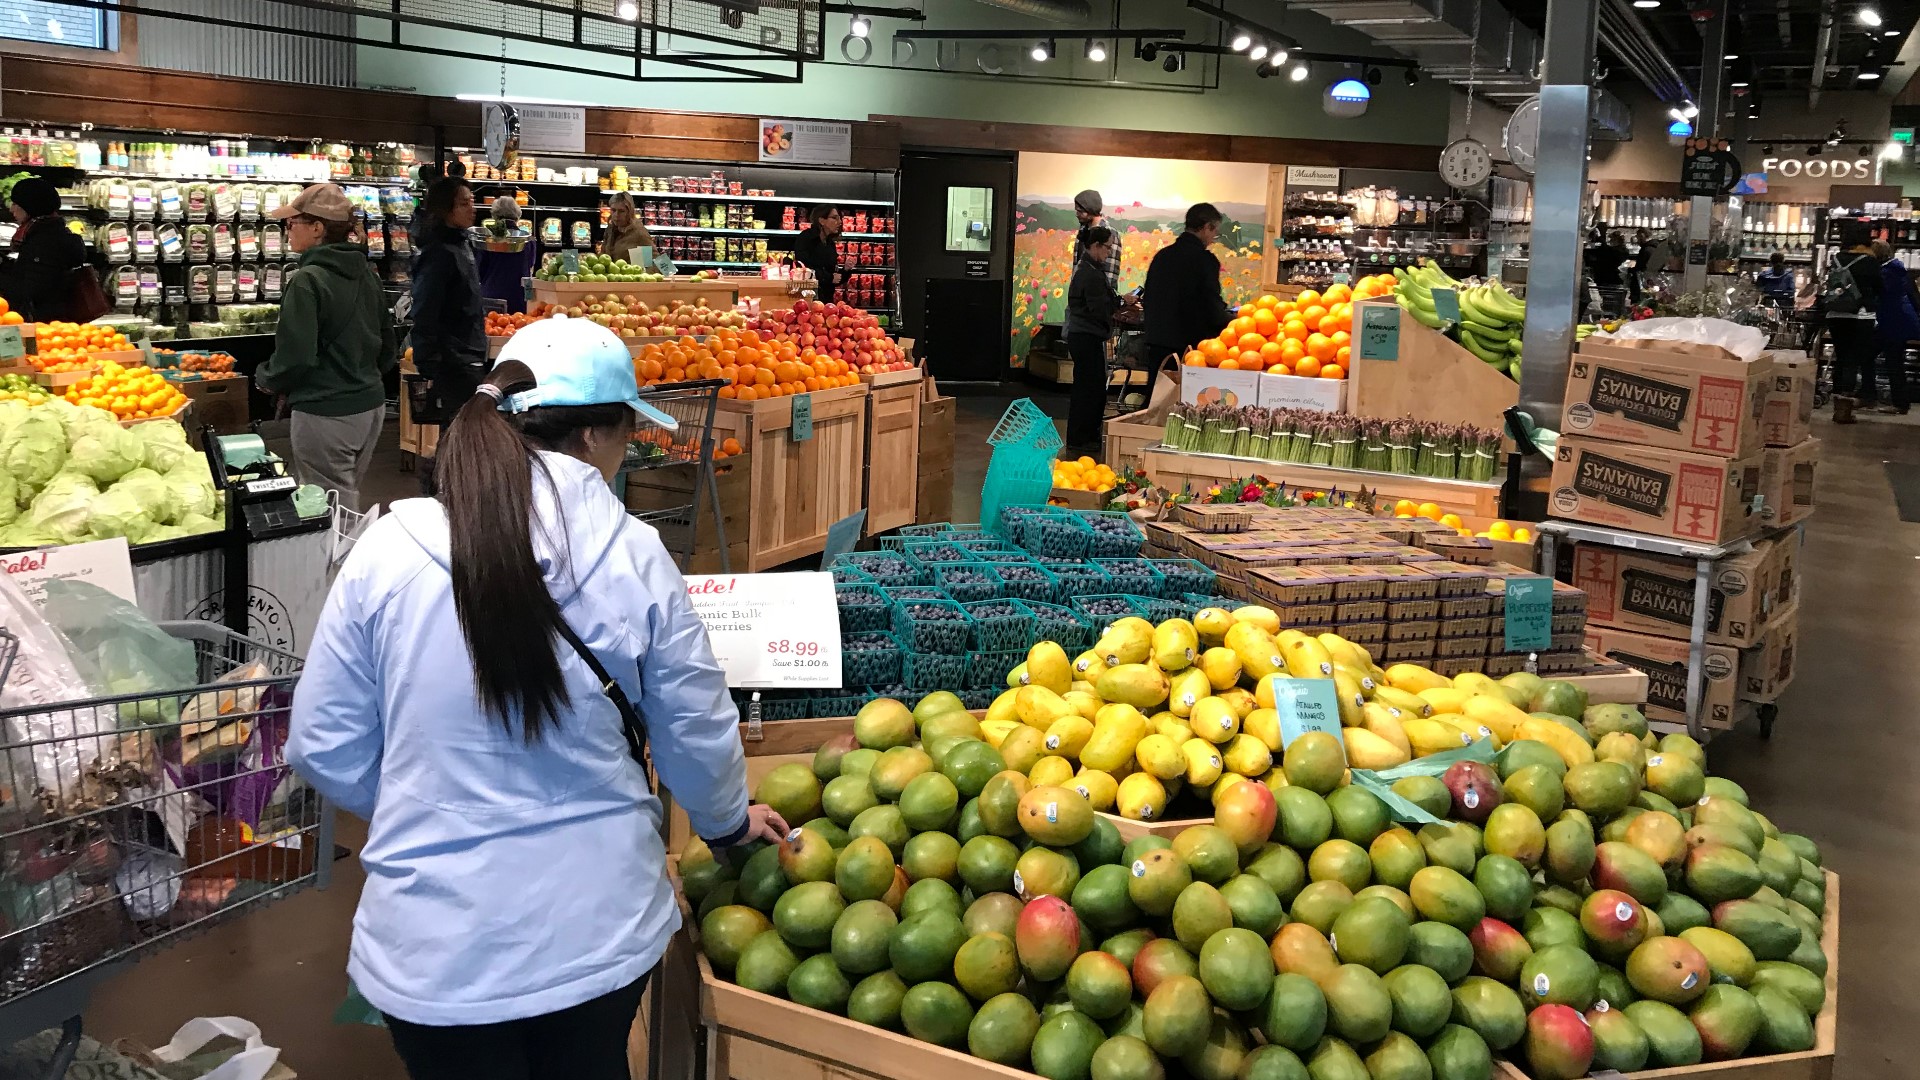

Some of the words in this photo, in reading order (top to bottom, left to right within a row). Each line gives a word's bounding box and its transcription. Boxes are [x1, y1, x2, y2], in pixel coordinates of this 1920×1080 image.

[760, 25, 1038, 76] PRODUC
[1294, 170, 1336, 178] Mushrooms
[1762, 158, 1870, 179] FOODS
[1302, 397, 1324, 407] citrus
[1597, 392, 1645, 412] EXCHANGE
[1600, 377, 1682, 411] BANANAS
[1649, 404, 1677, 420] EQUAL
[1580, 477, 1627, 496] EXCHANGE
[1583, 462, 1662, 497] BANANAS
[1630, 492, 1658, 506] EQUAL
[686, 578, 736, 595] ale!
[1508, 584, 1534, 600] Organic
[1634, 579, 1664, 594] EQUAL
[1666, 586, 1716, 606] EXCHE
[200, 596, 280, 624] CRENTO
[1630, 588, 1715, 622] BANANS
[700, 610, 728, 619] anic
[732, 609, 762, 619] Bulk
[706, 622, 752, 632] berries
[768, 639, 818, 656] $8.99
[772, 658, 792, 667] Save
[794, 659, 821, 667] $1.00
[1650, 670, 1688, 686] EXCHAN
[1296, 712, 1326, 720] MANGOS
